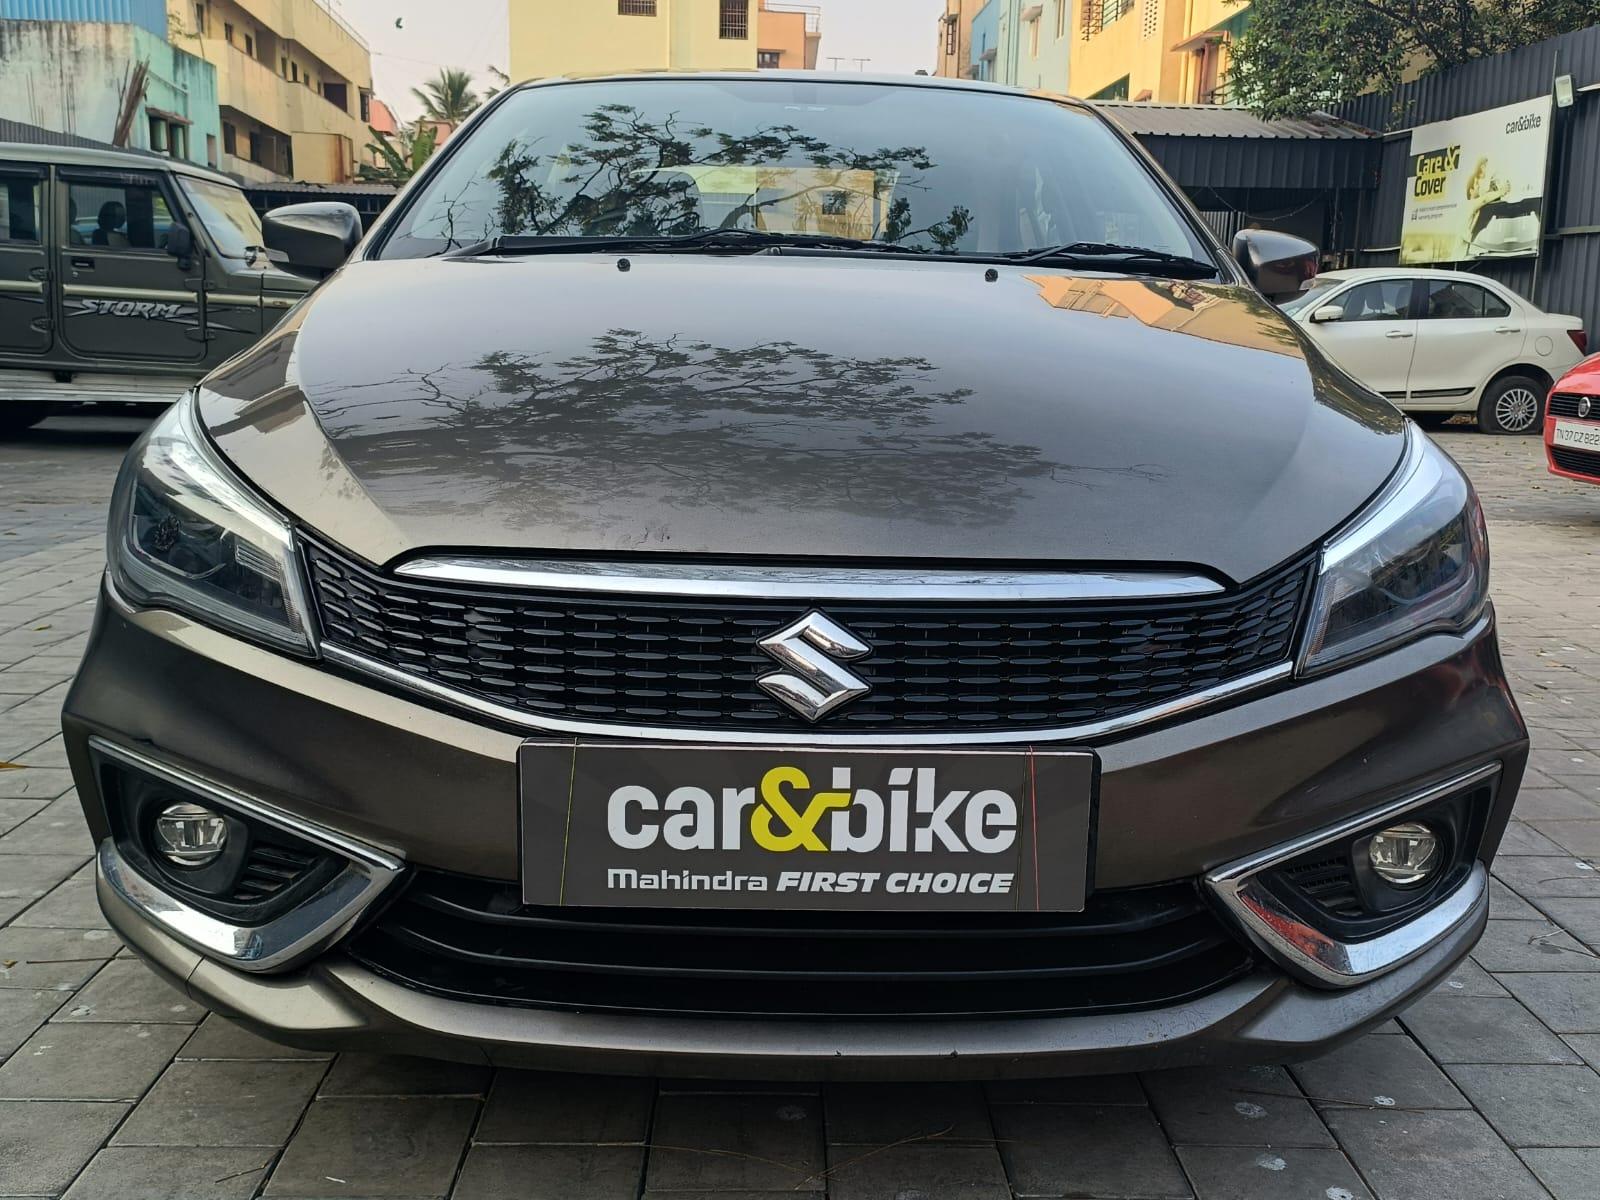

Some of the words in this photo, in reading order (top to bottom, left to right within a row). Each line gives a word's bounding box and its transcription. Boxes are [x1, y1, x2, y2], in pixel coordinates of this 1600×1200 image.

[1505, 113, 1541, 134] car&bike
[1416, 155, 1442, 176] Care
[1444, 144, 1460, 171] &
[1414, 175, 1446, 197] Cover
[81, 299, 181, 319] STORM
[607, 766, 1017, 853] car&bike
[607, 868, 768, 892] Mahindra
[775, 871, 880, 894] FIRST
[886, 872, 1014, 894] CHOICE
